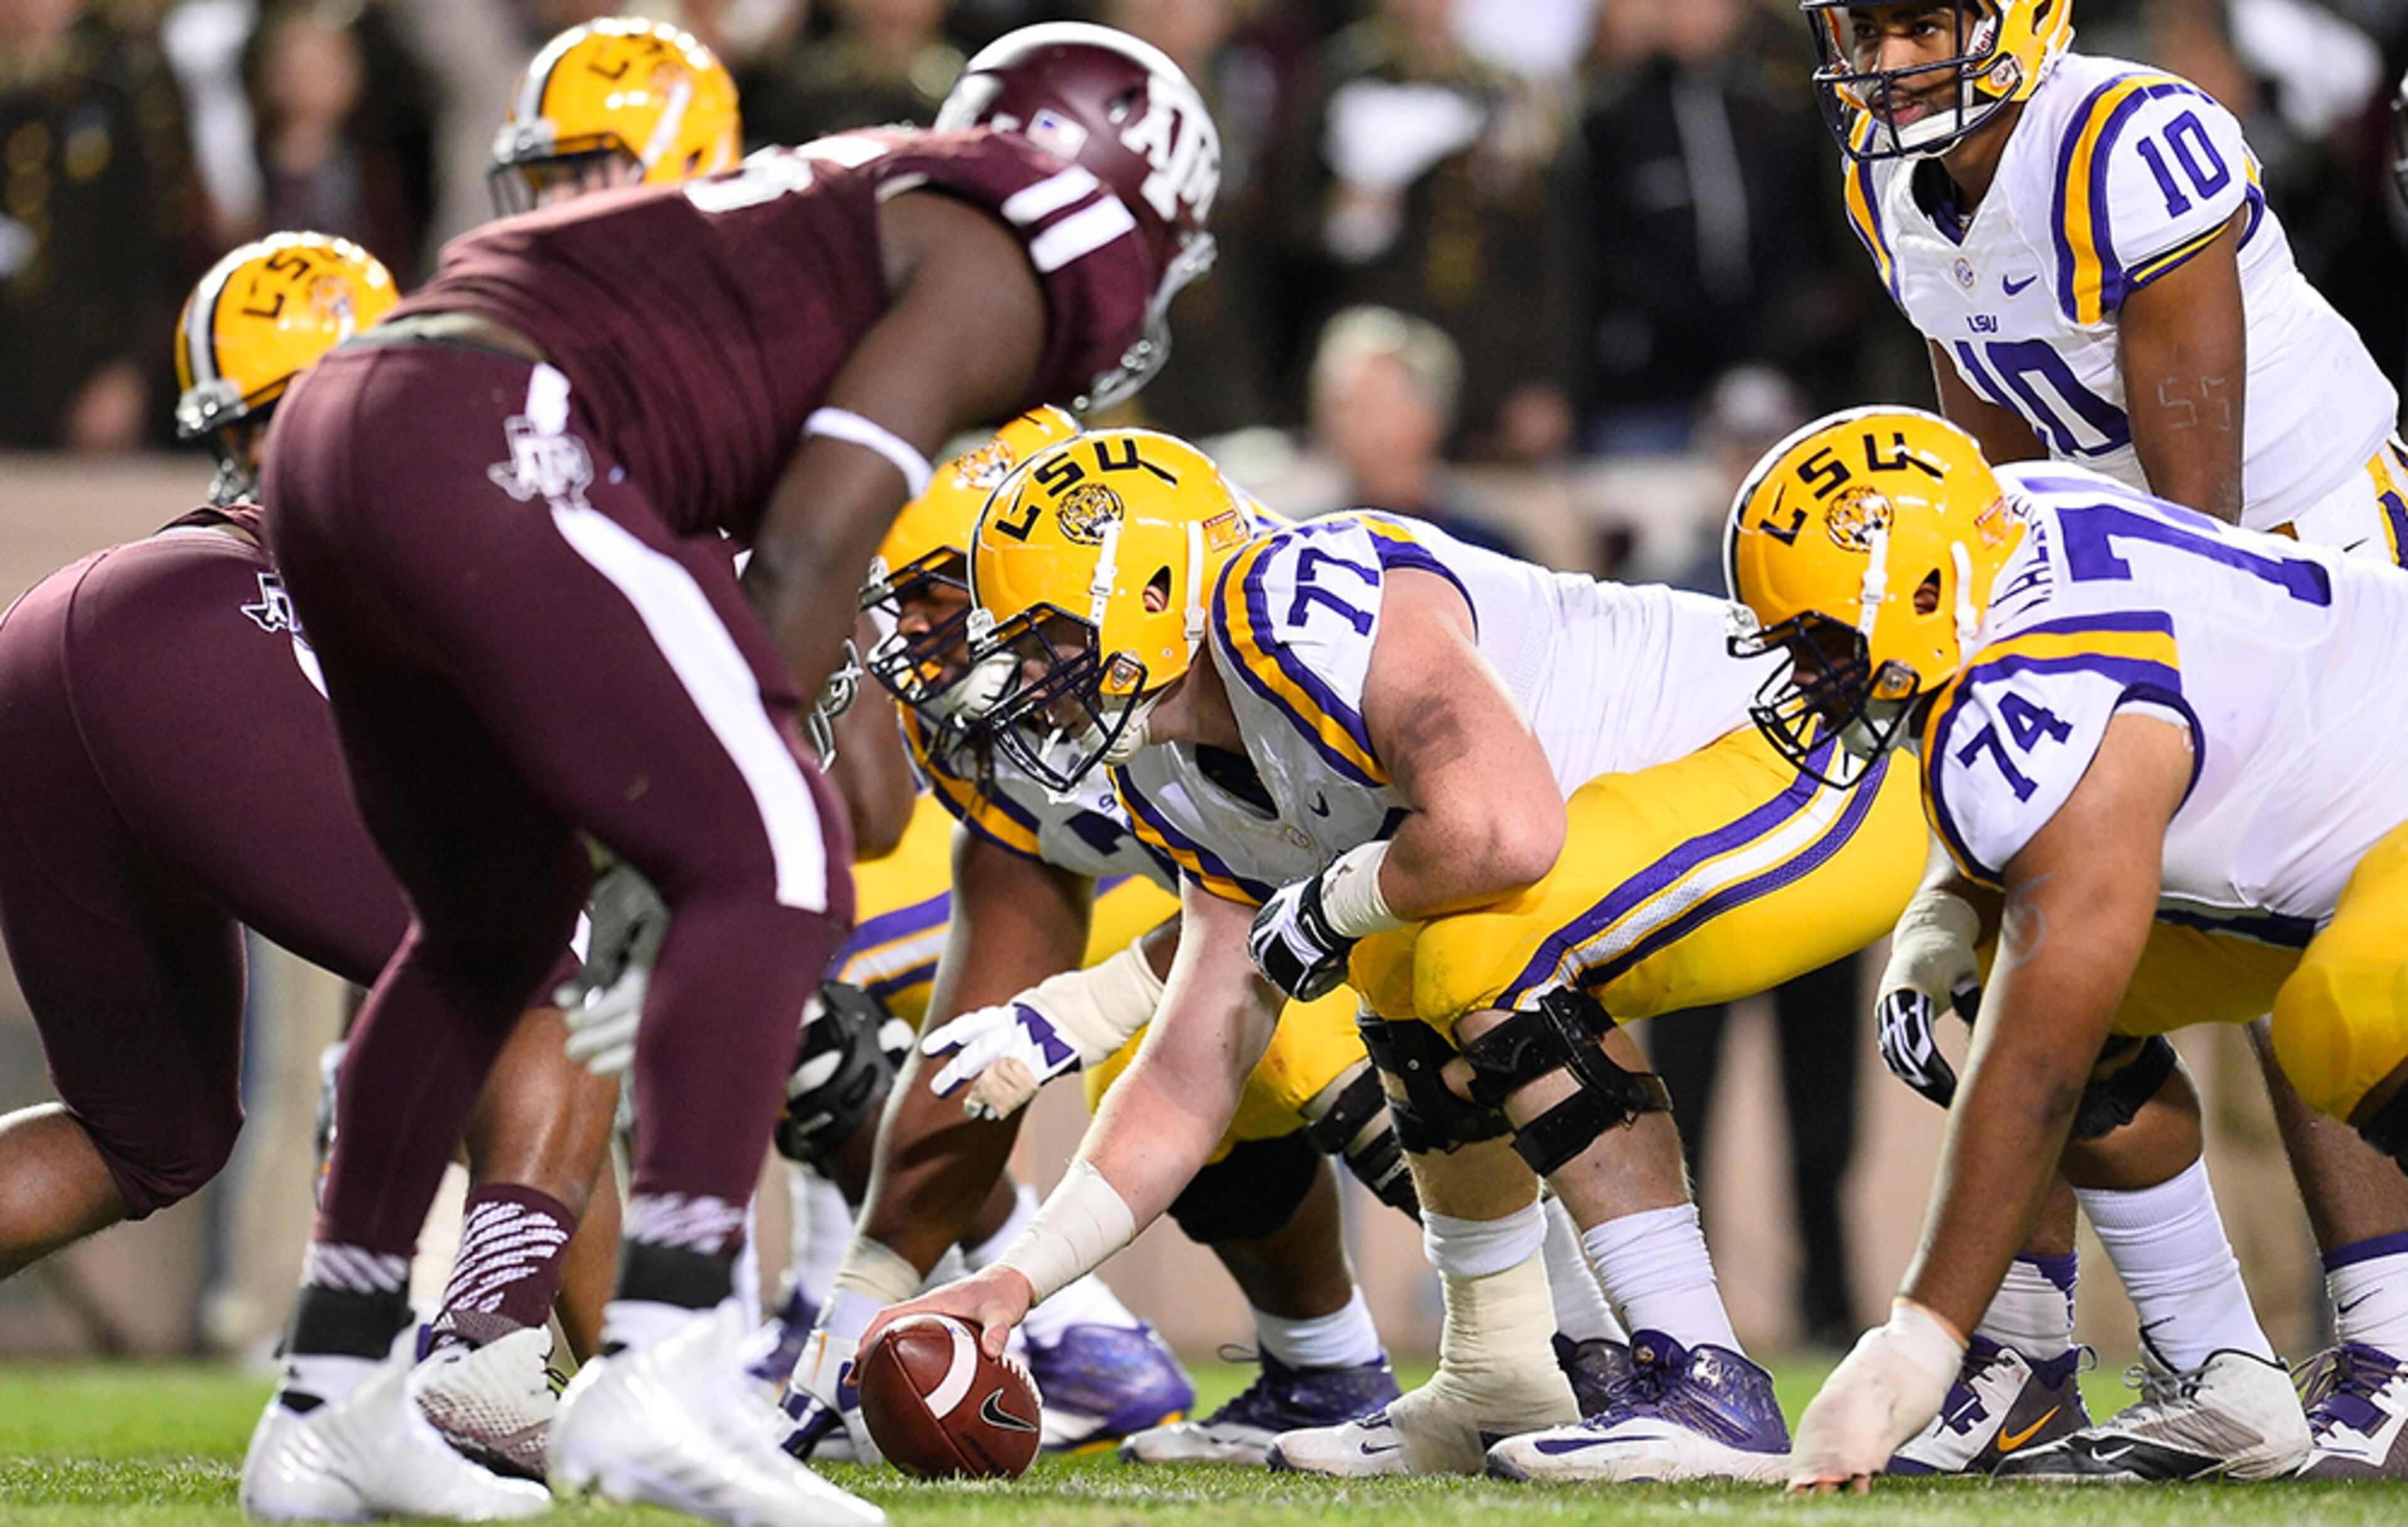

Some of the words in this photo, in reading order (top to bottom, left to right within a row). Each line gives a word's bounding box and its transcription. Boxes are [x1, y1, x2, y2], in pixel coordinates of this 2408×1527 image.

[2136, 110, 2231, 219] 10
[1967, 315, 1998, 332] LSU
[1954, 339, 2132, 457] 10
[995, 438, 1139, 542] LSU
[1758, 431, 1908, 547] LSU
[1287, 547, 1380, 637] 77
[1956, 690, 2073, 803] 74
